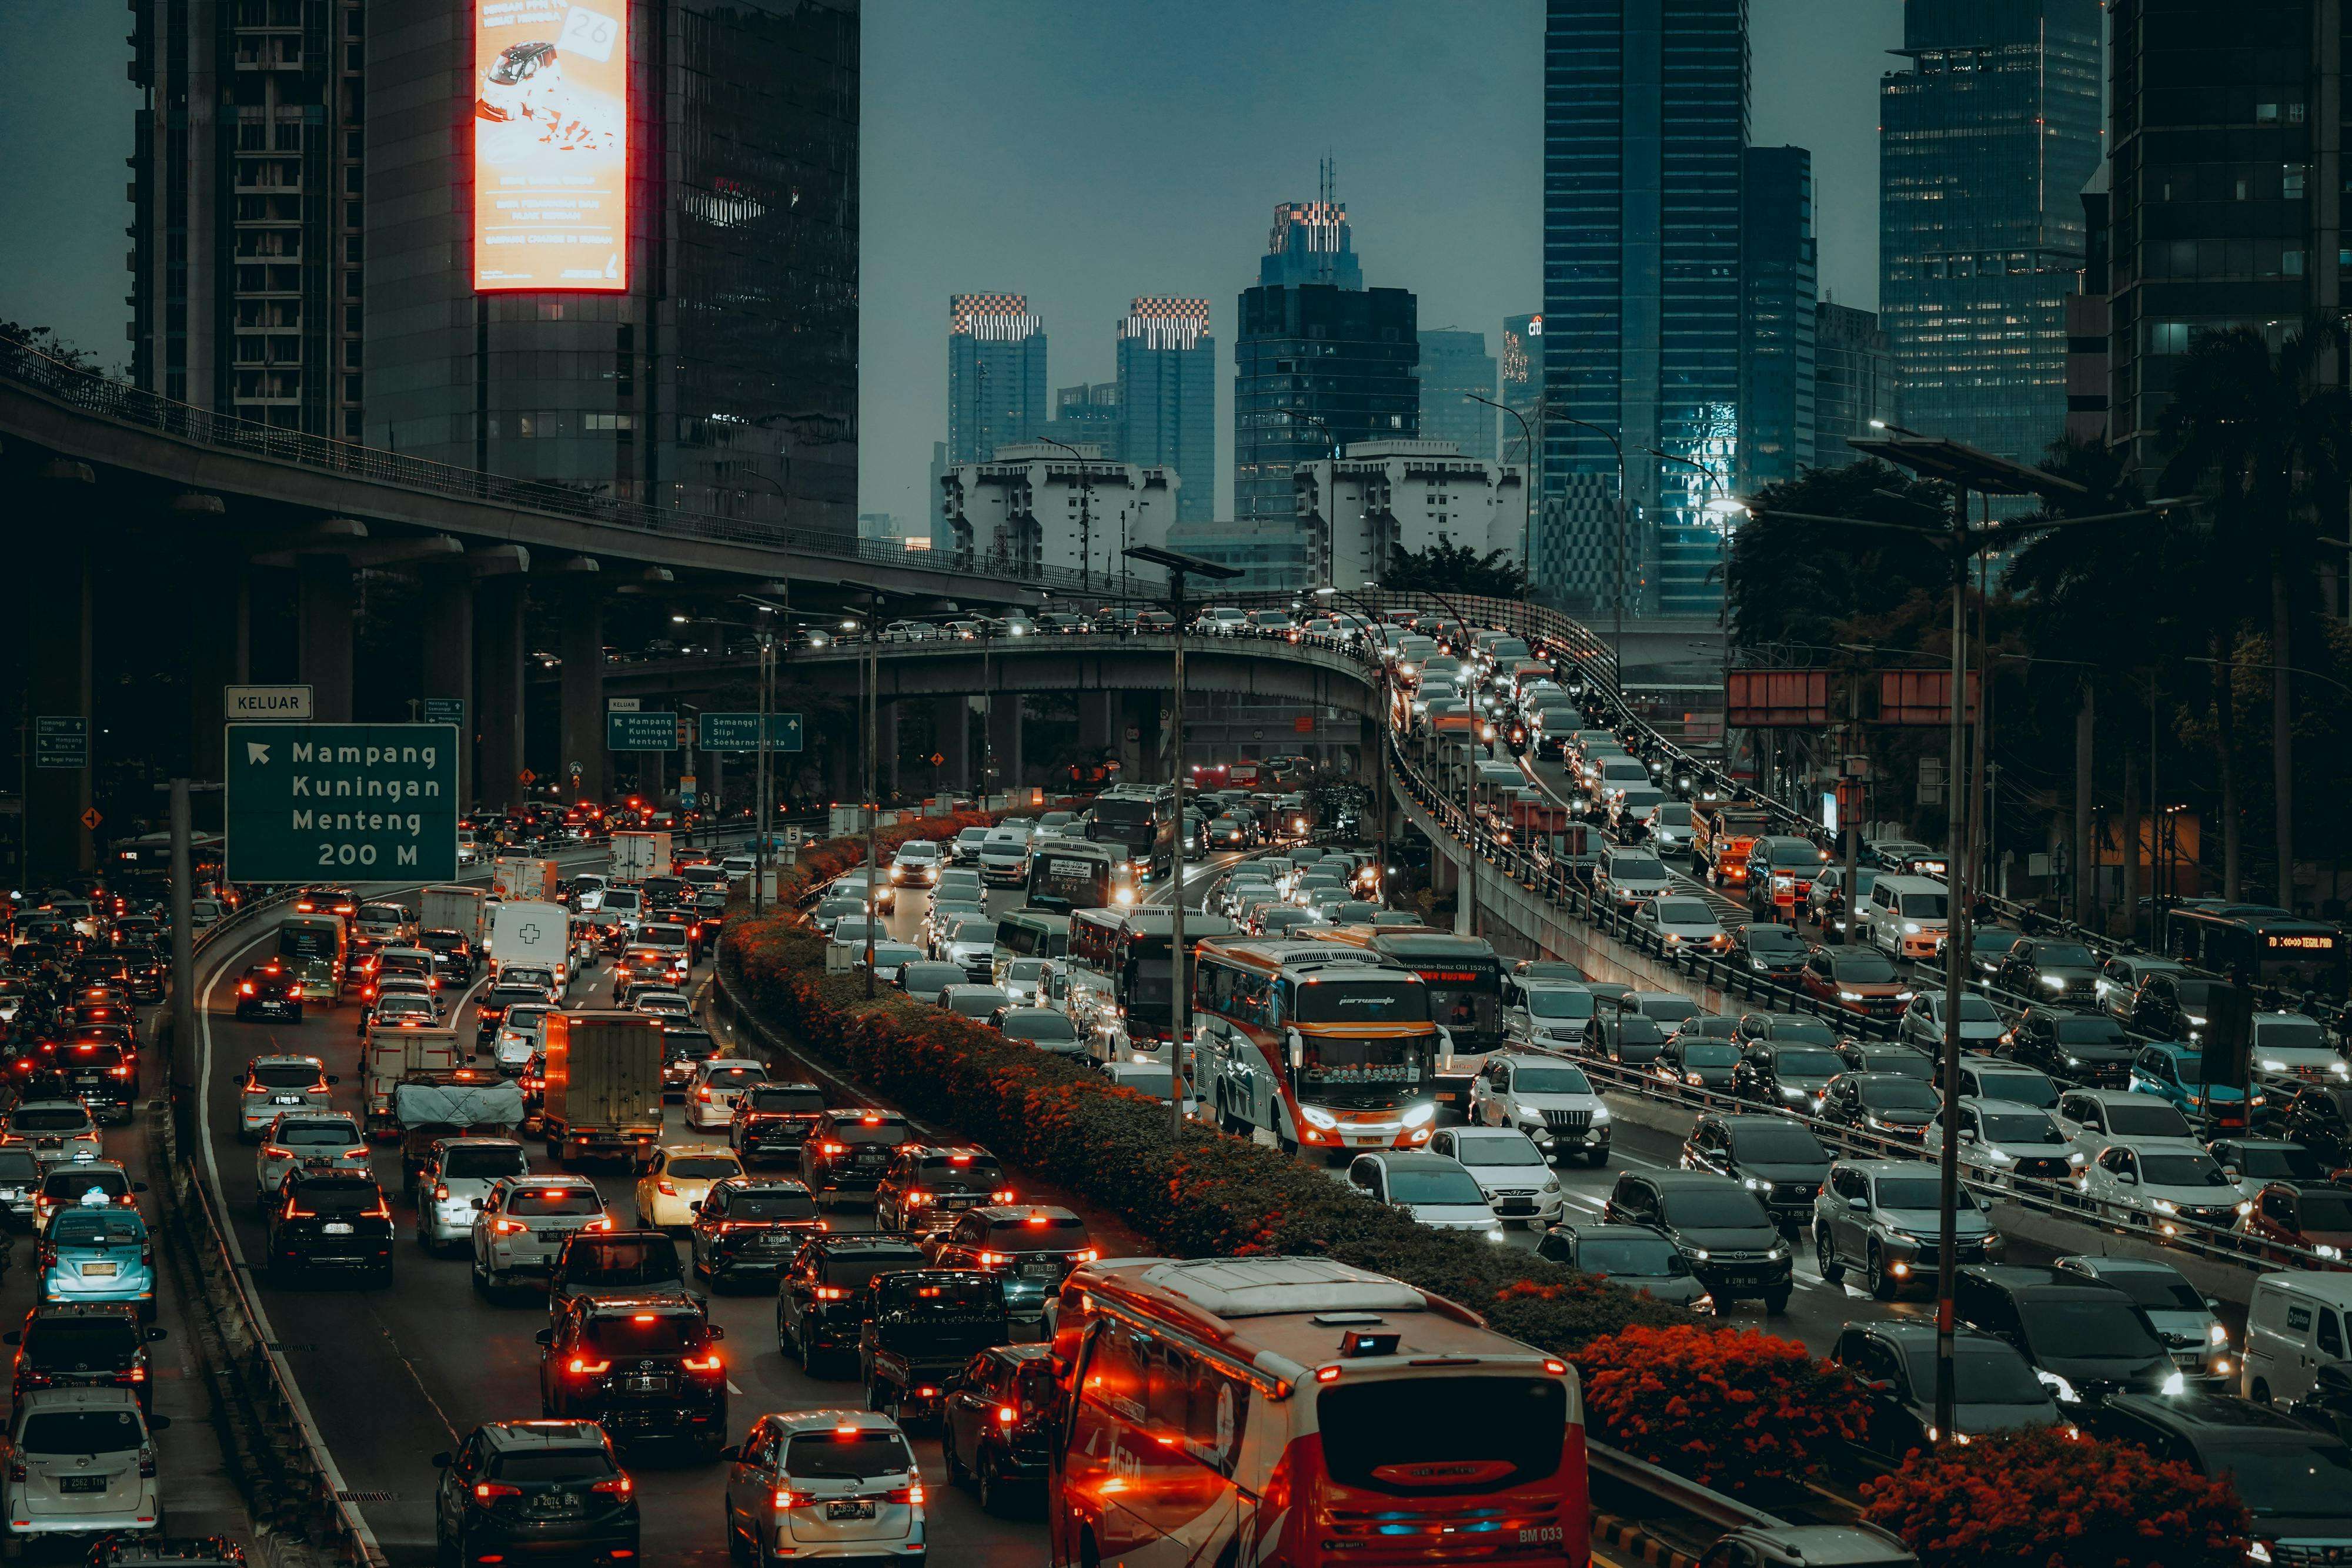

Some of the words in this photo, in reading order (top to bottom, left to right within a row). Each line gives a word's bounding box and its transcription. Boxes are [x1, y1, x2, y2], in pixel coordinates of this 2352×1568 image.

[572, 14, 608, 44] 26
[238, 697, 299, 709] KELUAR
[629, 718, 671, 726] Mampang
[713, 718, 757, 727] Semanggi
[629, 728, 673, 737] Kuningan
[629, 738, 668, 747] Menteng
[293, 743, 436, 770] Mampang
[293, 776, 439, 803] Kuningan
[293, 810, 420, 837] Menteng
[790, 833, 797, 841] 5
[318, 844, 377, 865] 200
[397, 845, 417, 865] M
[2269, 937, 2277, 947] 7D
[1402, 962, 1454, 971] Mercedes-Benz
[72, 1477, 88, 1487] 2562
[92, 1477, 104, 1486] TYN
[533, 1498, 539, 1506] B
[543, 1497, 559, 1506] 2074
[1519, 1529, 1538, 1543] BM
[1541, 1526, 1563, 1541] 033
